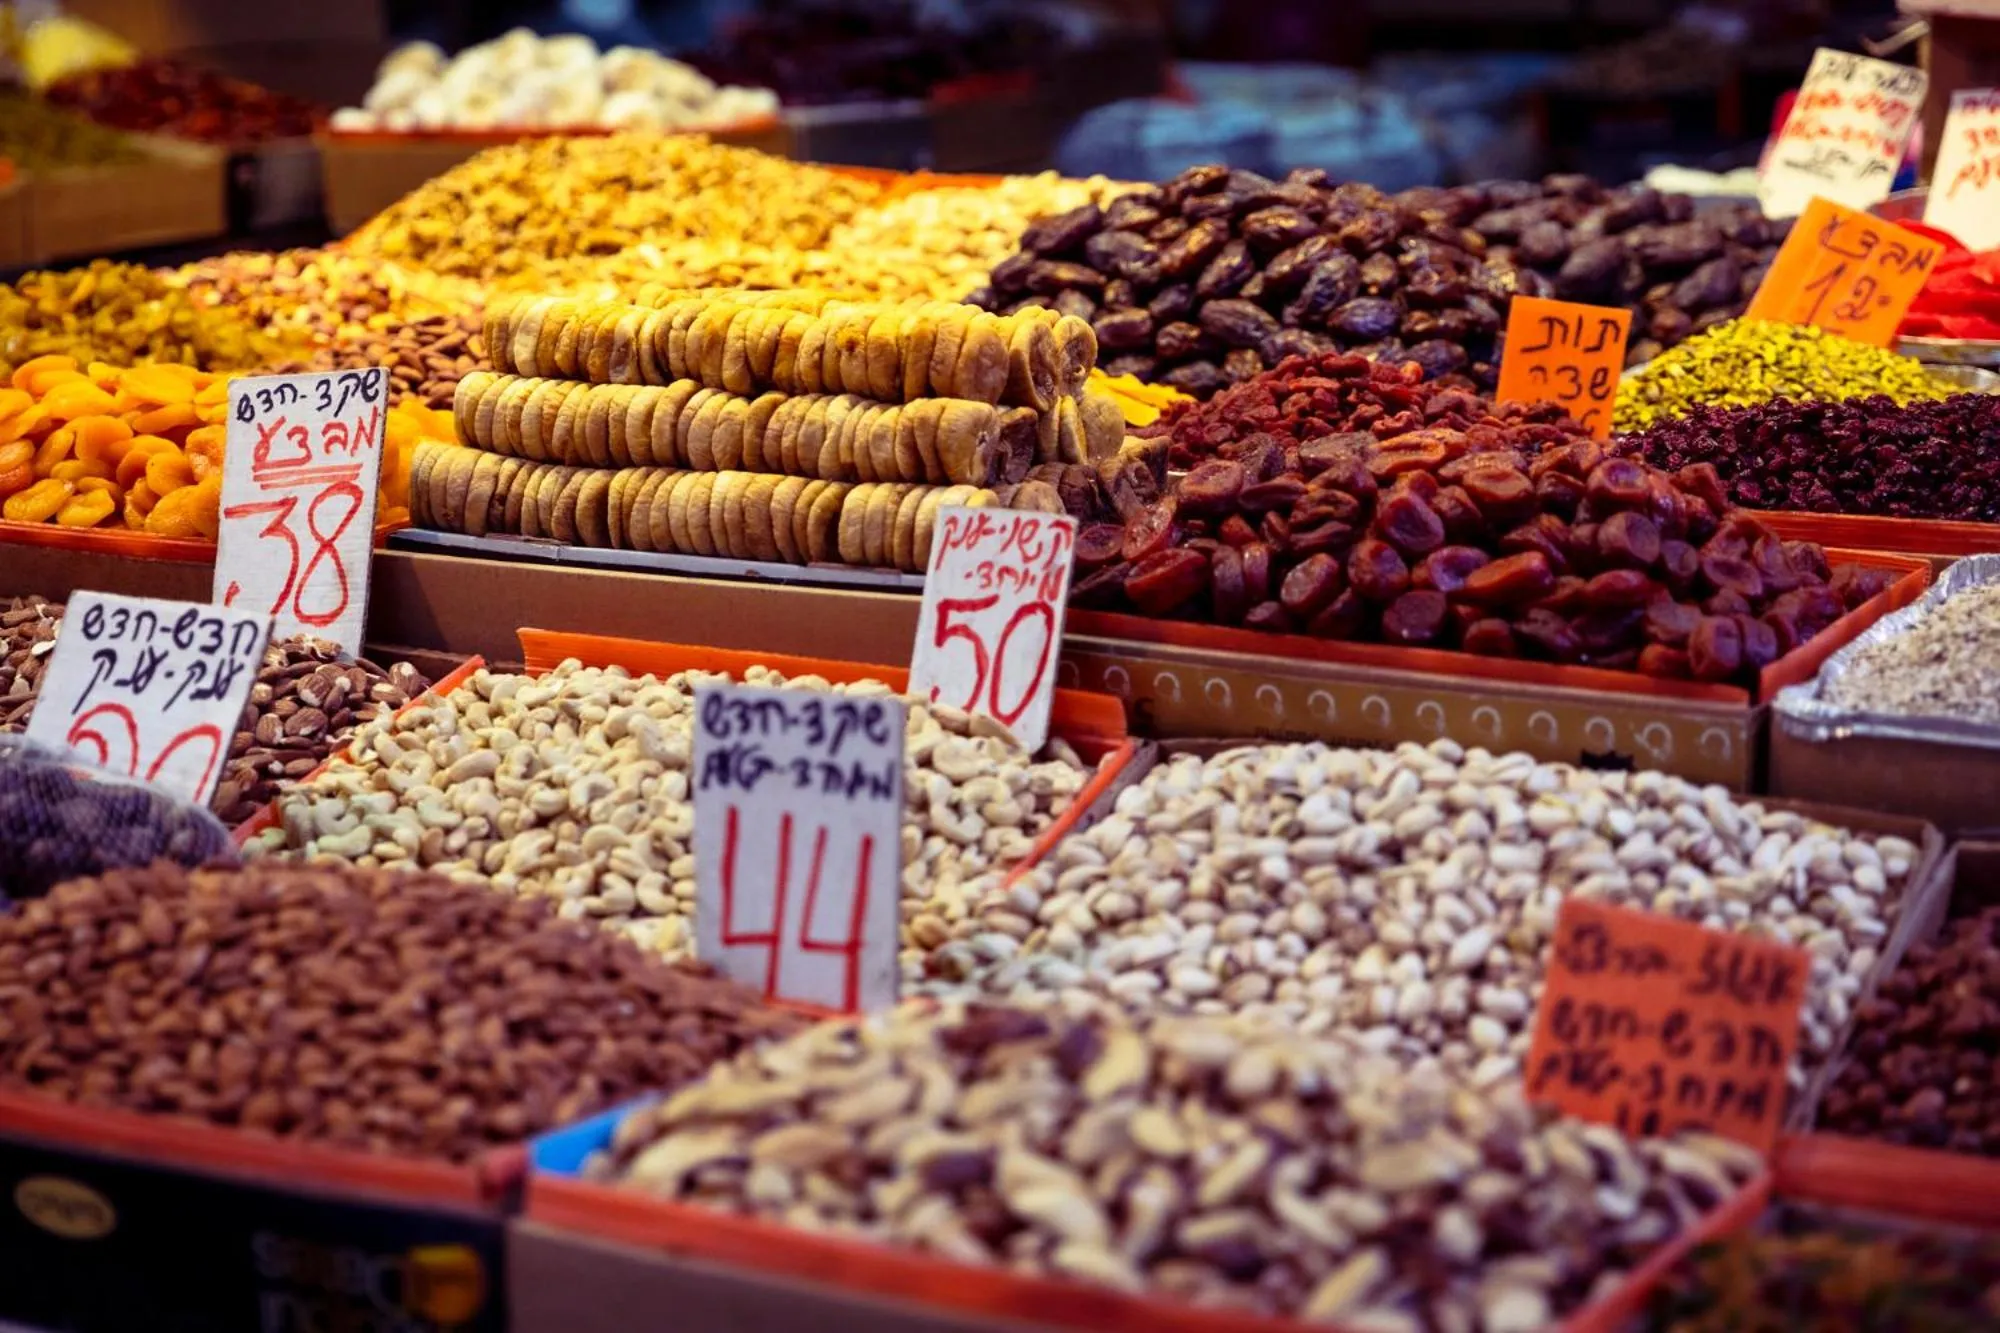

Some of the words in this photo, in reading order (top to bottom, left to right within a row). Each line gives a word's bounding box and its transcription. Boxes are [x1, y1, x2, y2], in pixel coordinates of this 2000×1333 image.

[1519, 314, 1621, 354] תות
[1529, 366, 1612, 401] שדה
[252, 405, 378, 472] מבצע
[719, 804, 876, 1014] 44
